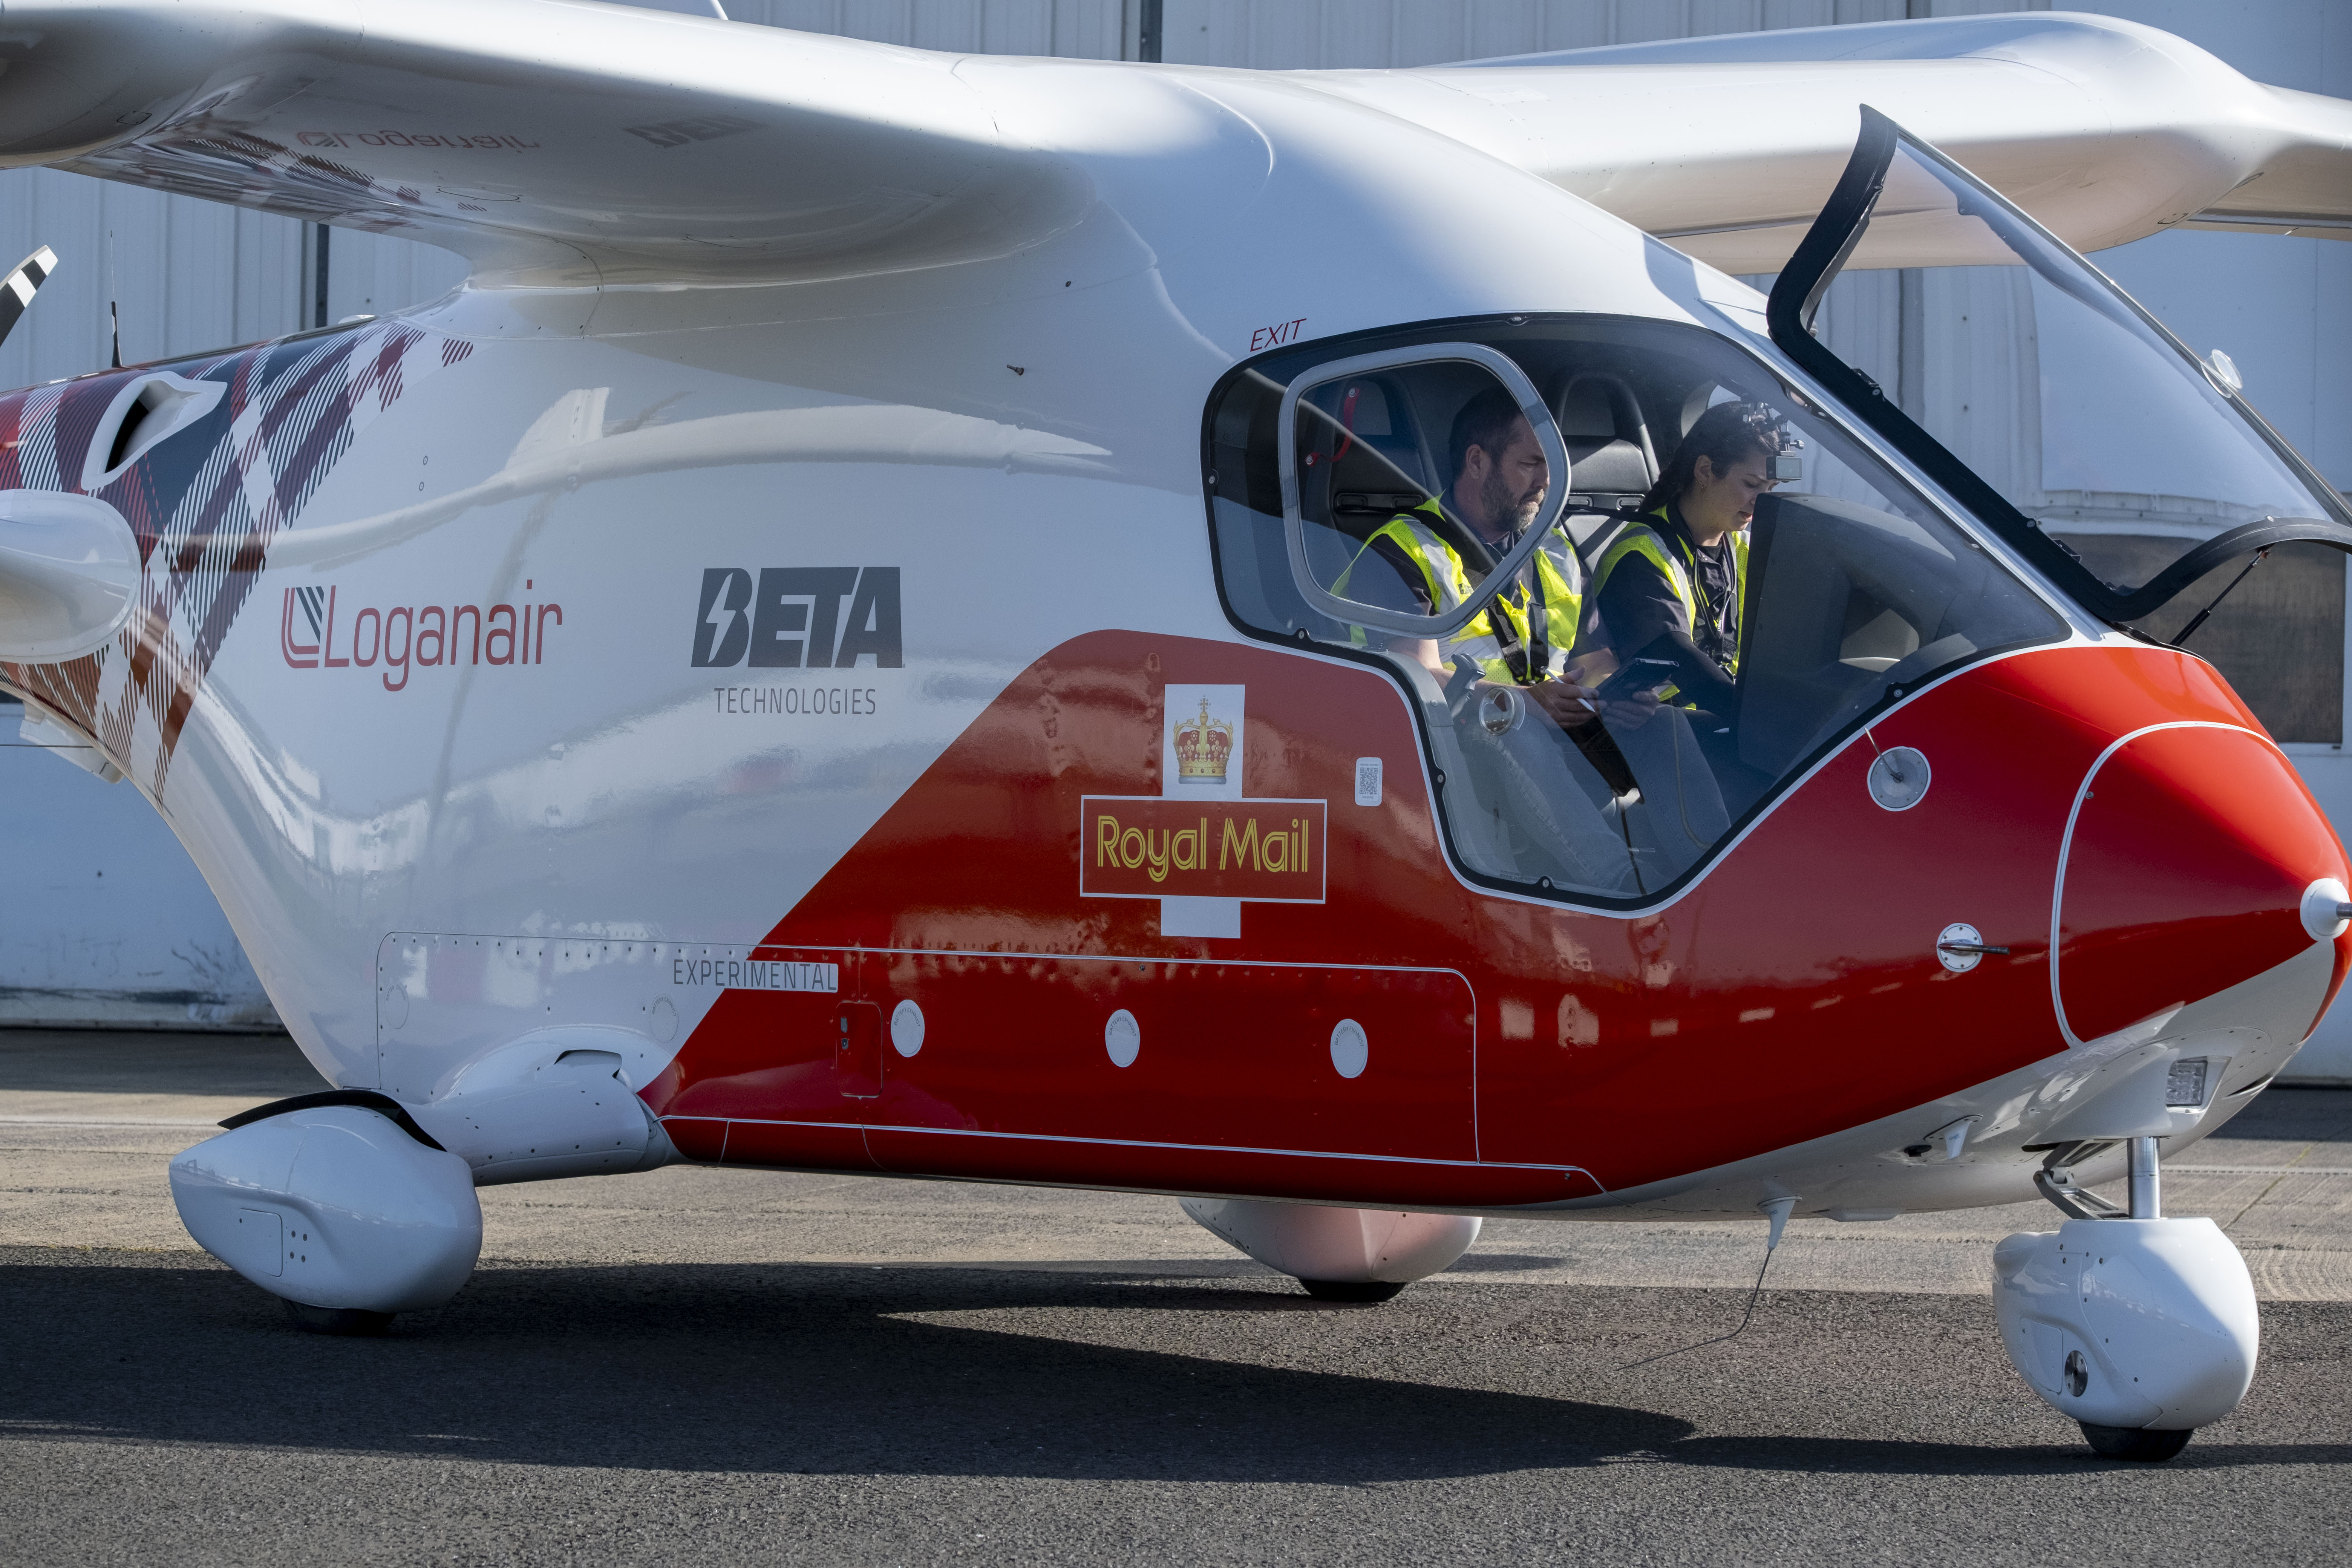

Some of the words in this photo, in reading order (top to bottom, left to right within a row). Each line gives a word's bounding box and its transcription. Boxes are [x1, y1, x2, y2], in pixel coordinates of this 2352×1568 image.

[1251, 318, 1307, 352] EXIT
[691, 567, 903, 669] BETA
[324, 579, 562, 692] Loganair
[714, 688, 876, 715] TECHNOLOGIES
[1097, 815, 1207, 882] Royal
[1219, 818, 1309, 873] Mail
[674, 960, 837, 990] EXPERIMENTAL
[651, 997, 663, 1015] BATTERY
[894, 1008, 906, 1025] BATTERY
[908, 1008, 920, 1027] EXHAUST
[1109, 1017, 1121, 1035] BATTERY
[1122, 1017, 1136, 1036] EXHAUST
[1335, 1026, 1348, 1045] BATTERY
[1349, 1026, 1363, 1046] EXHAUST
